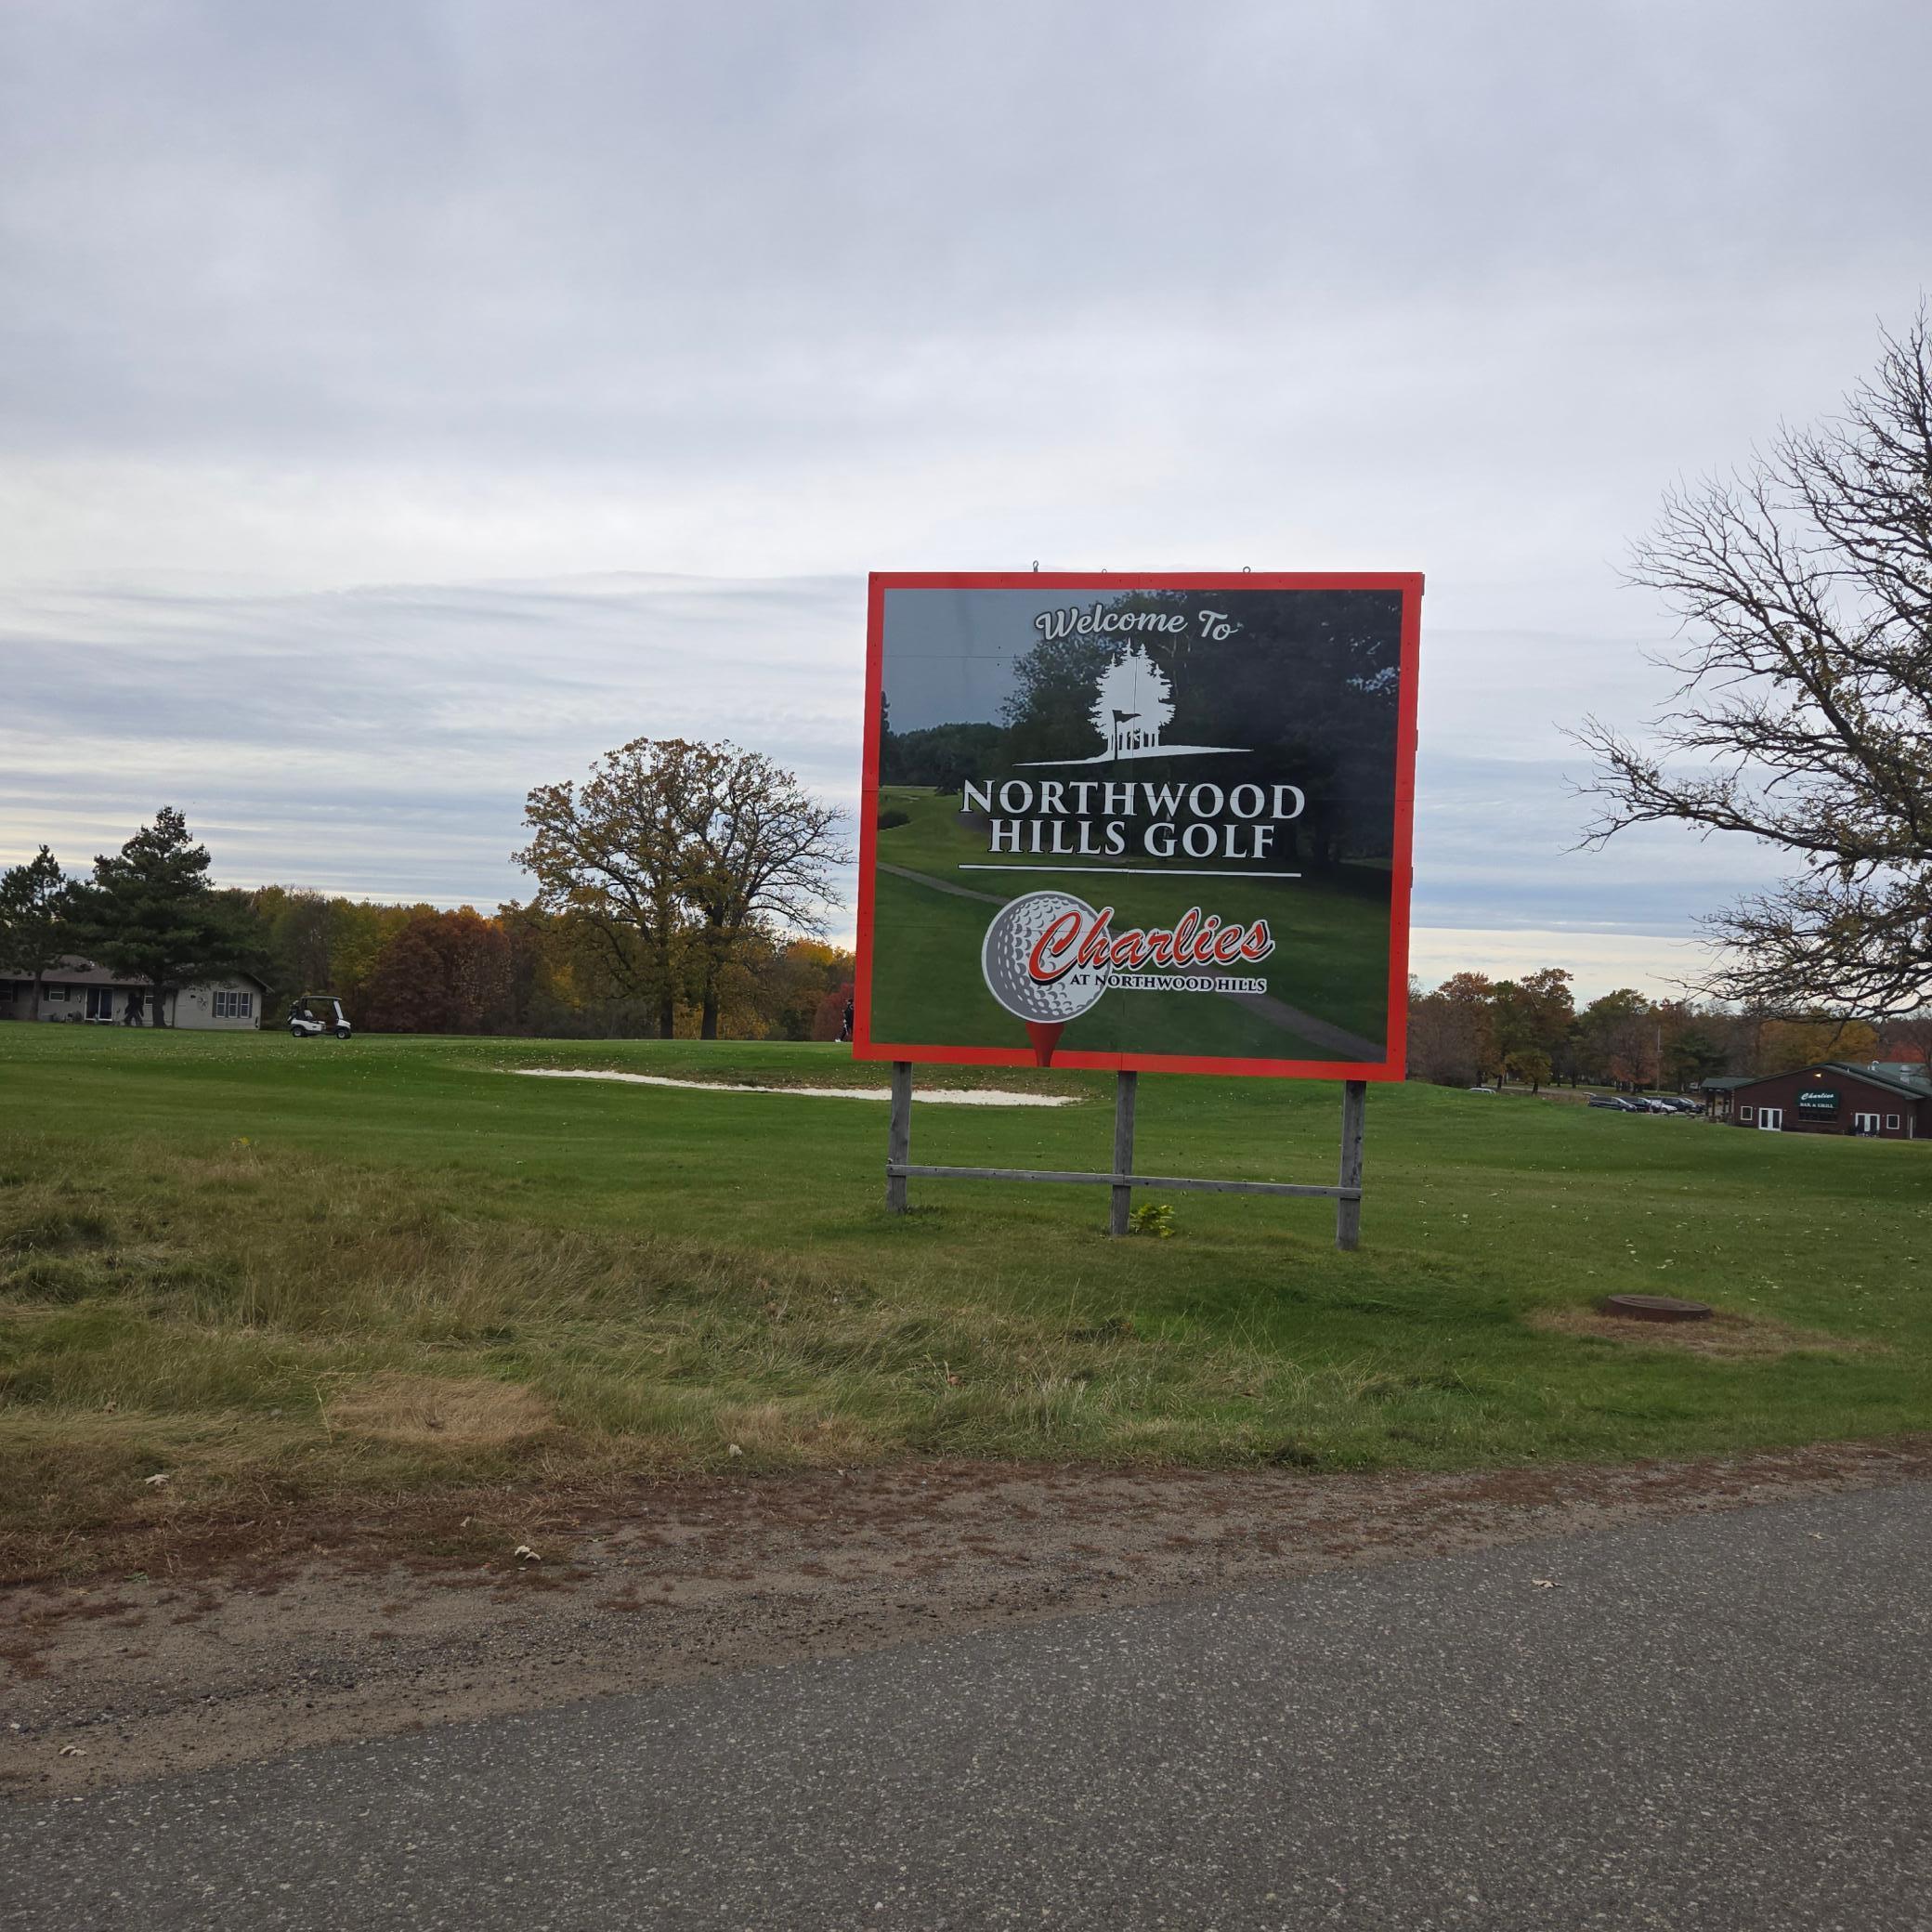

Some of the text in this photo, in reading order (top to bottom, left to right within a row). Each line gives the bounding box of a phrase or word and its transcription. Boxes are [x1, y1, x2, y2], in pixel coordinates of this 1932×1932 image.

[1035, 603, 1240, 641] Welcome To
[959, 778, 1306, 819] NORTHWOOD
[987, 818, 1275, 859] HILLS GOLF
[1028, 907, 1274, 986] Charlies
[1070, 974, 1266, 992] AT NORTHWOOD HILLS
[1801, 1092, 1834, 1101] Charlies
